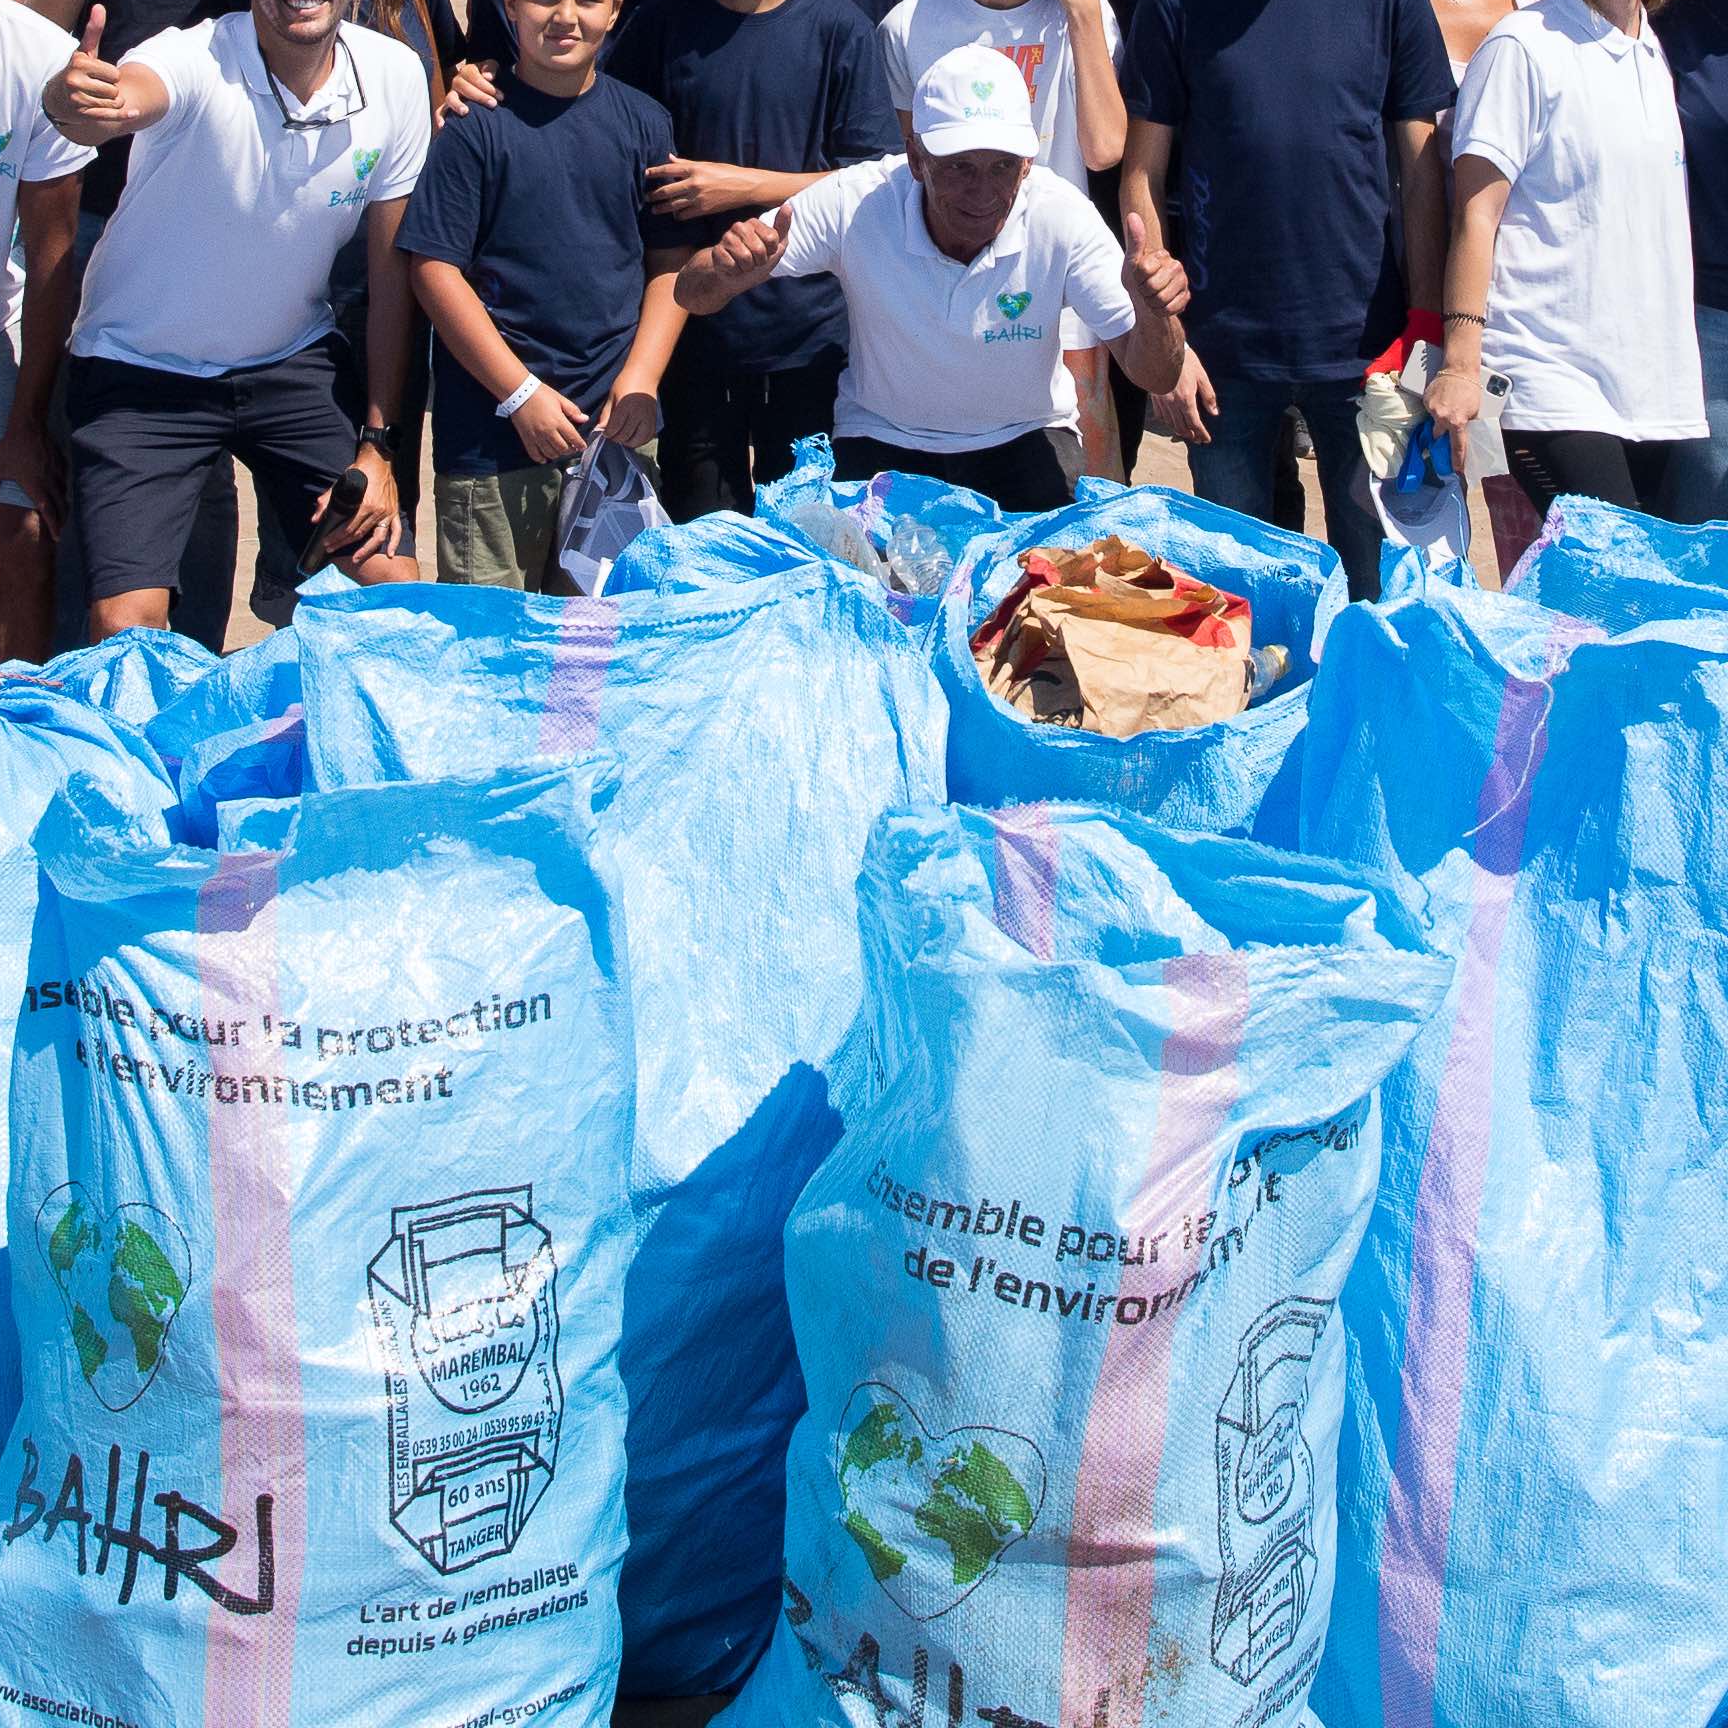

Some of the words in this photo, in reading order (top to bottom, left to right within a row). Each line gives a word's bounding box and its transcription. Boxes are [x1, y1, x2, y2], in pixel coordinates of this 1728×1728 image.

[963, 105, 1005, 121] BAHRI
[983, 326, 1043, 345] BAHRI
[150, 1008, 246, 1046] pour
[262, 1014, 302, 1051] la
[317, 989, 553, 1060] protection
[866, 1159, 1045, 1247] Ensemble
[1055, 1222, 1166, 1267] pour
[1183, 1209, 1218, 1250] la
[904, 1246, 955, 1287] de
[430, 1341, 527, 1384] MAREMBAL
[460, 1373, 501, 1403] 1962
[393, 1379, 410, 1469] EMBALLAGES
[413, 1437, 438, 1457] 0539
[440, 1435, 451, 1452] 35
[452, 1431, 465, 1447] 00
[466, 1427, 478, 1443] 24
[484, 1419, 507, 1438] 0539
[508, 1416, 520, 1431] 95
[521, 1413, 533, 1428] 99
[534, 1410, 546, 1426] 43
[397, 1472, 410, 1497] LES
[448, 1486, 470, 1508] 60
[474, 1476, 505, 1499] ans
[1260, 1472, 1285, 1508] 1962
[2, 1433, 273, 1615] BAHRI
[448, 1524, 504, 1559] TANGER
[360, 1602, 421, 1624] L'art
[428, 1596, 457, 1619] de
[461, 1561, 579, 1611] l'emballage
[1255, 1588, 1272, 1617] 60
[1272, 1573, 1290, 1599] ans
[347, 1631, 435, 1659] depuis
[441, 1626, 458, 1646] 4
[463, 1588, 589, 1646] générations
